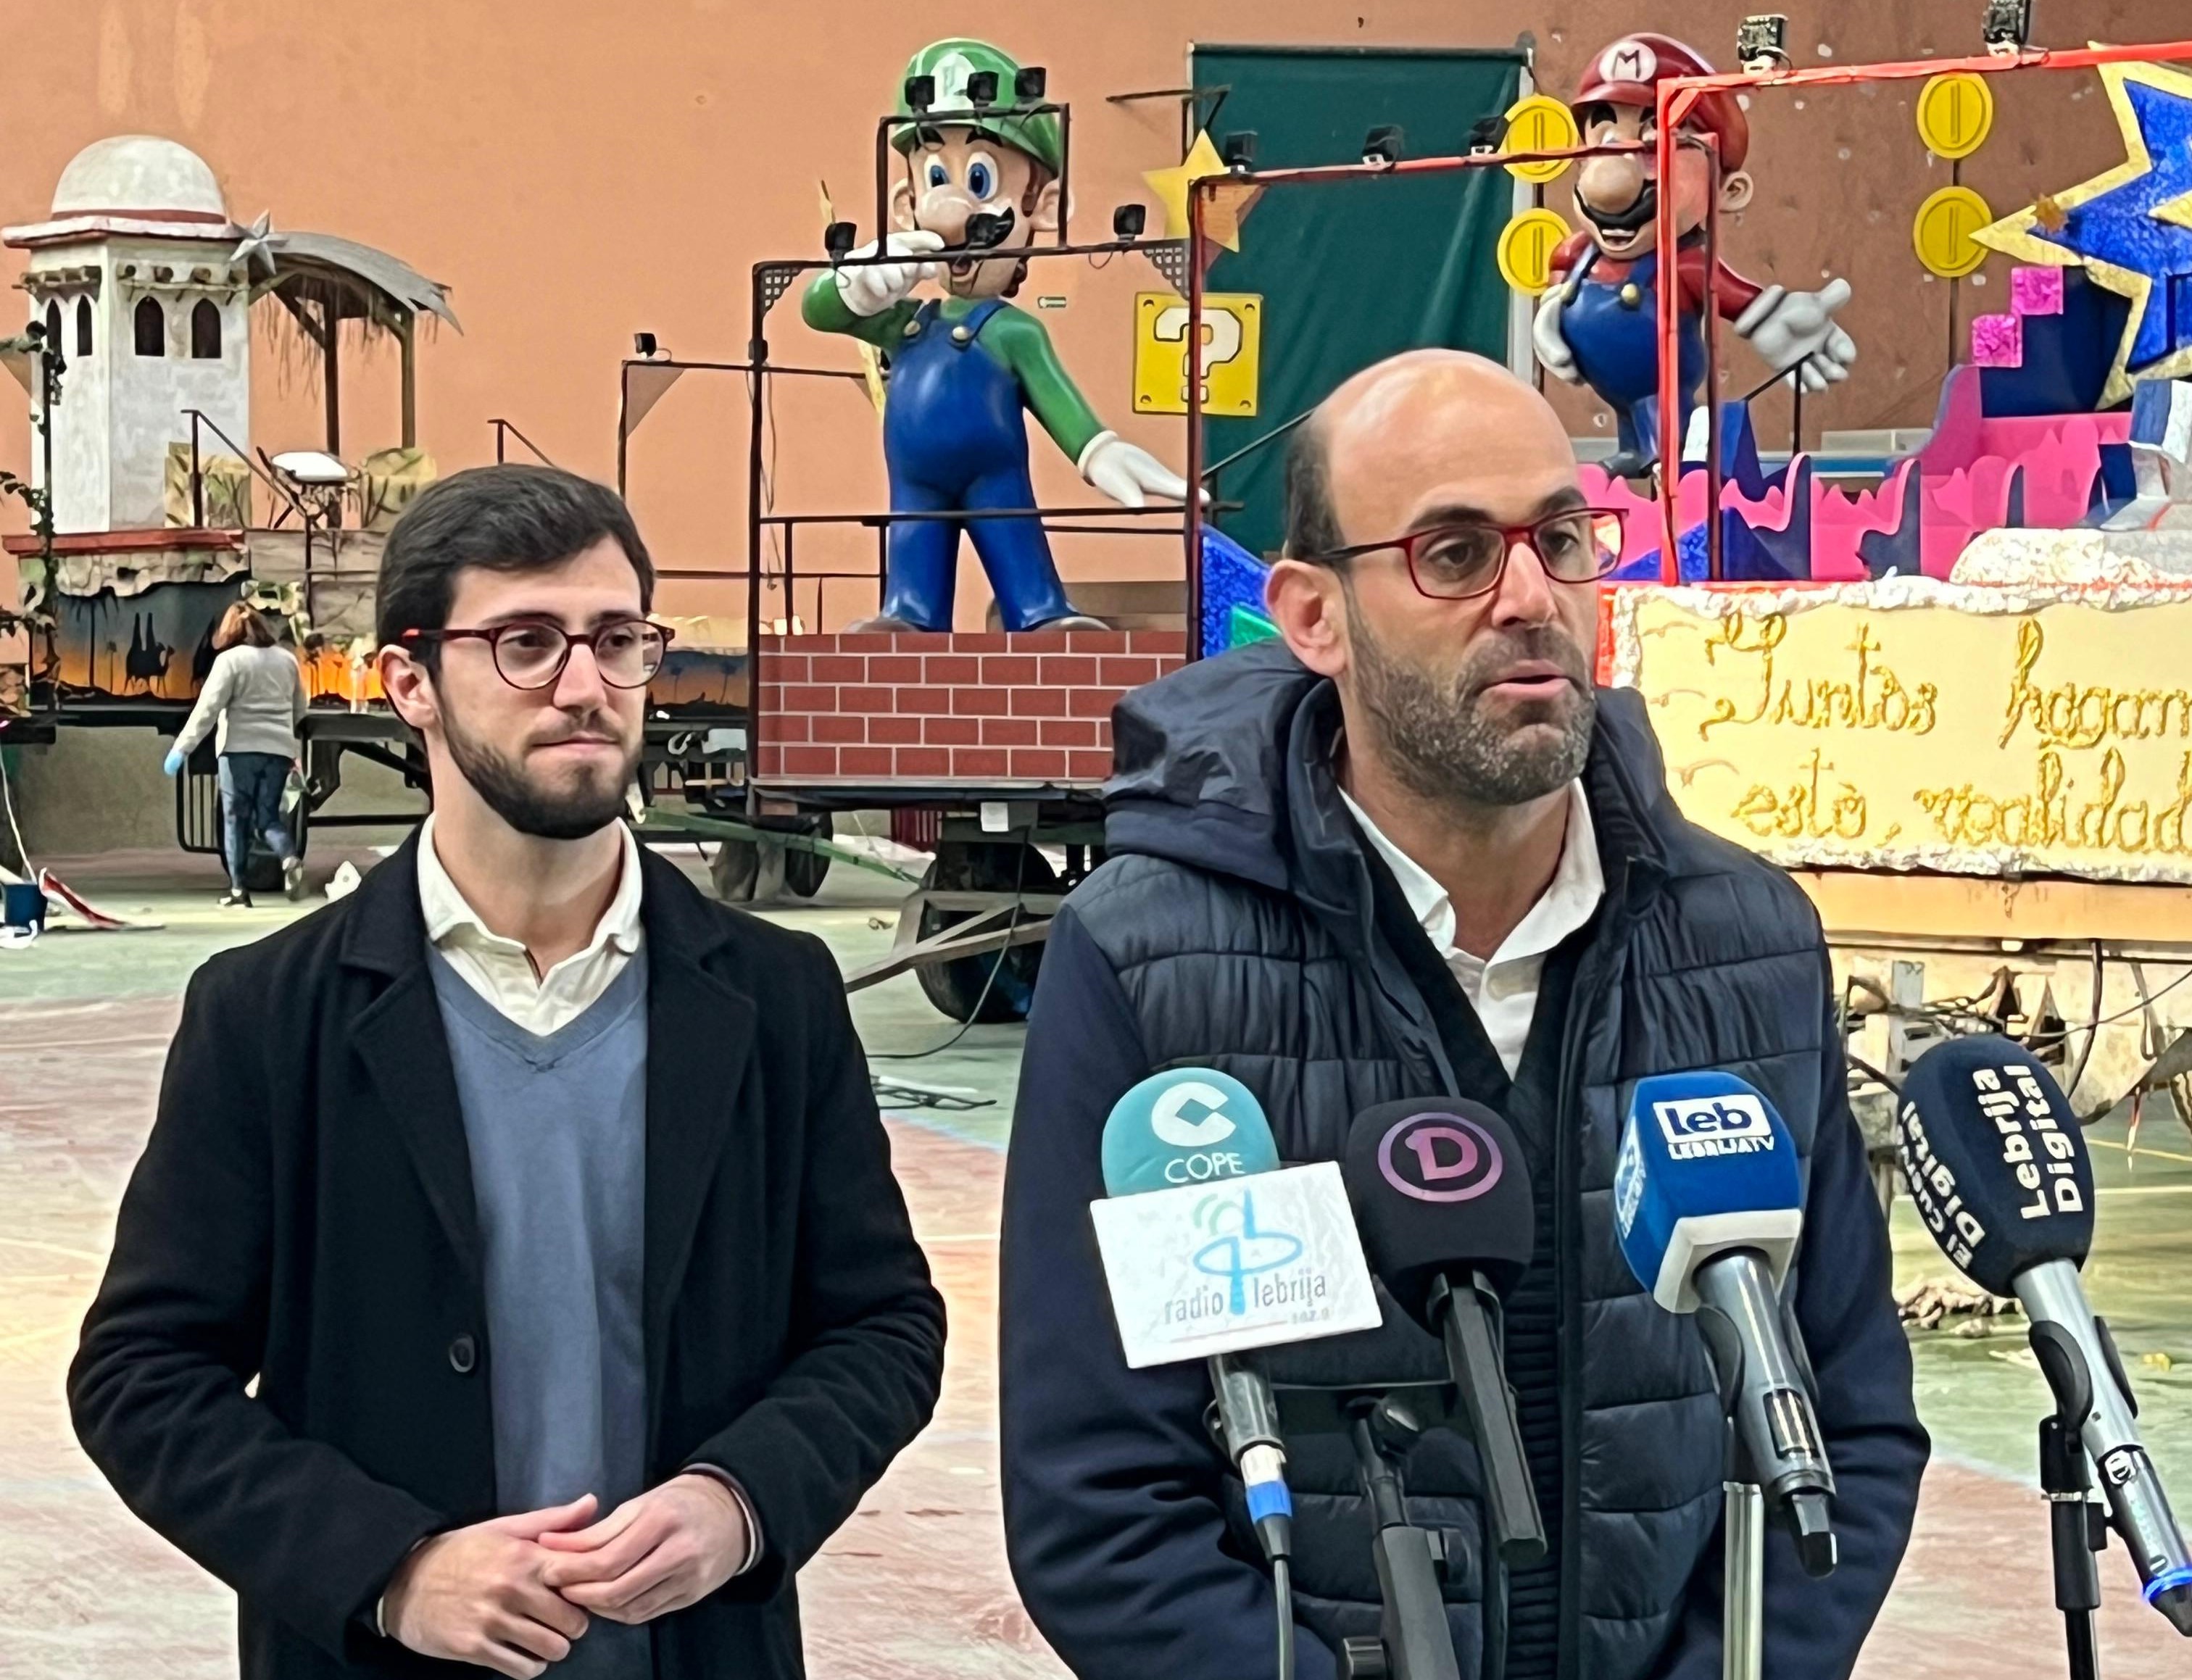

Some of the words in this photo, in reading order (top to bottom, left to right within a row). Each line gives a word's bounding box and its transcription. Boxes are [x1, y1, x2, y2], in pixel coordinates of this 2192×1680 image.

[1611, 49, 1642, 79] M
[1699, 610, 1938, 741] Juntos
[1665, 1102, 1752, 1136] Leb
[1972, 1068, 2051, 1220] Lebrija
[2003, 1065, 2084, 1213] Digital
[1164, 1152, 1246, 1183] COPE
[1164, 1284, 1224, 1325] radio
[1253, 1268, 1327, 1308] lebrija
